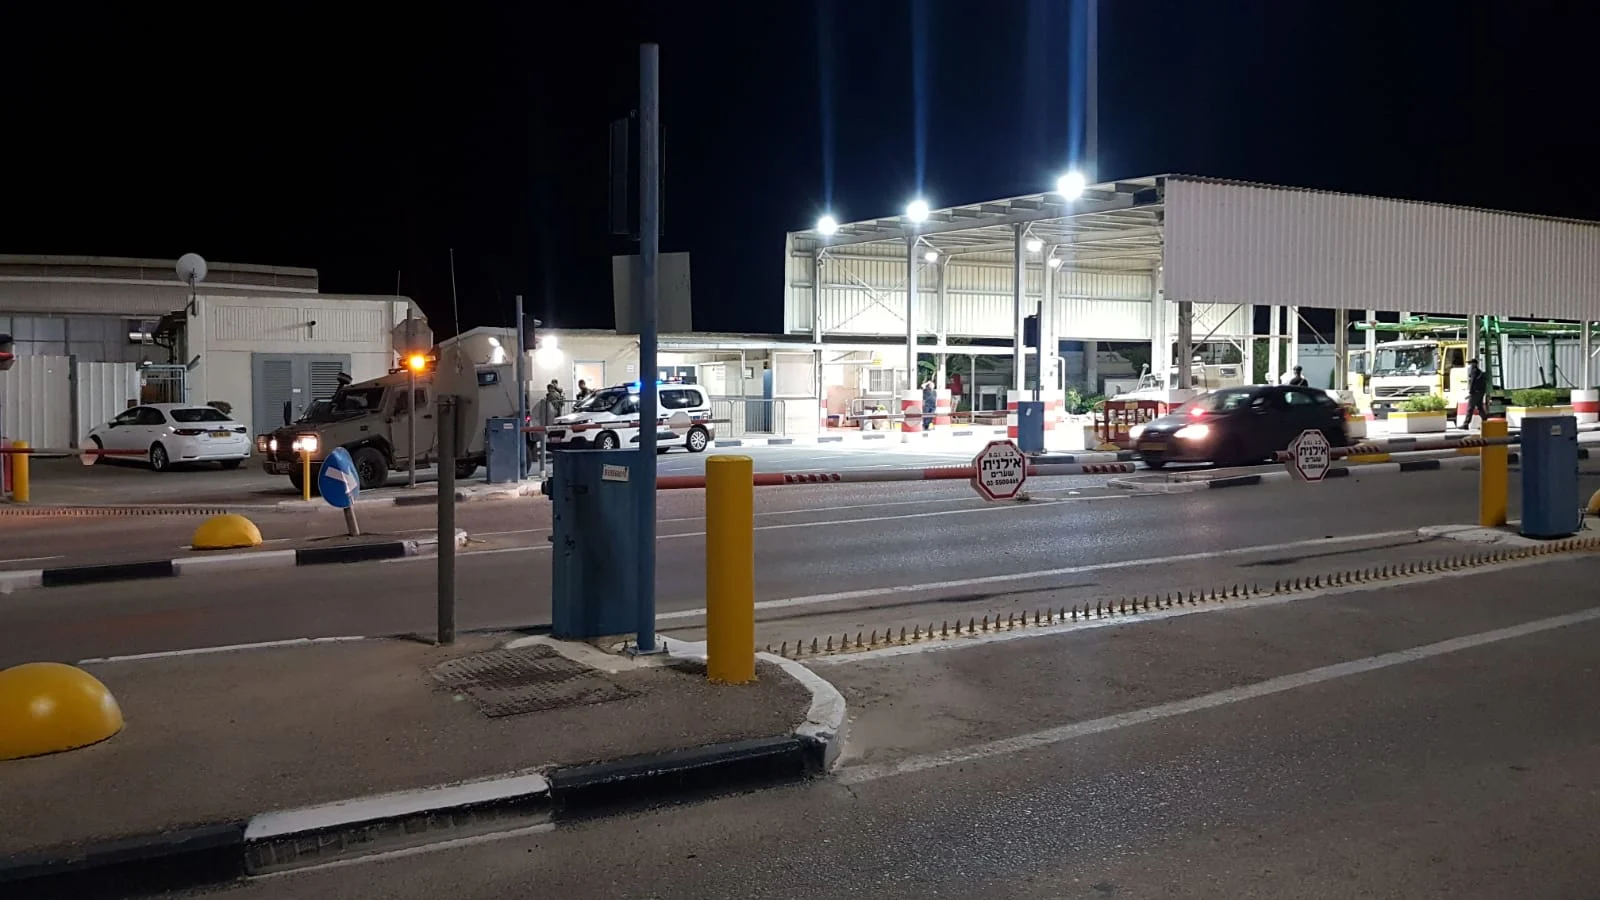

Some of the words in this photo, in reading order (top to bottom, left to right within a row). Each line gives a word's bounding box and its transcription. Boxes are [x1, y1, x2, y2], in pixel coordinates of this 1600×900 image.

[1299, 445, 1327, 456] אילנית
[982, 457, 1021, 470] אילנית
[990, 470, 1015, 478] שערים
